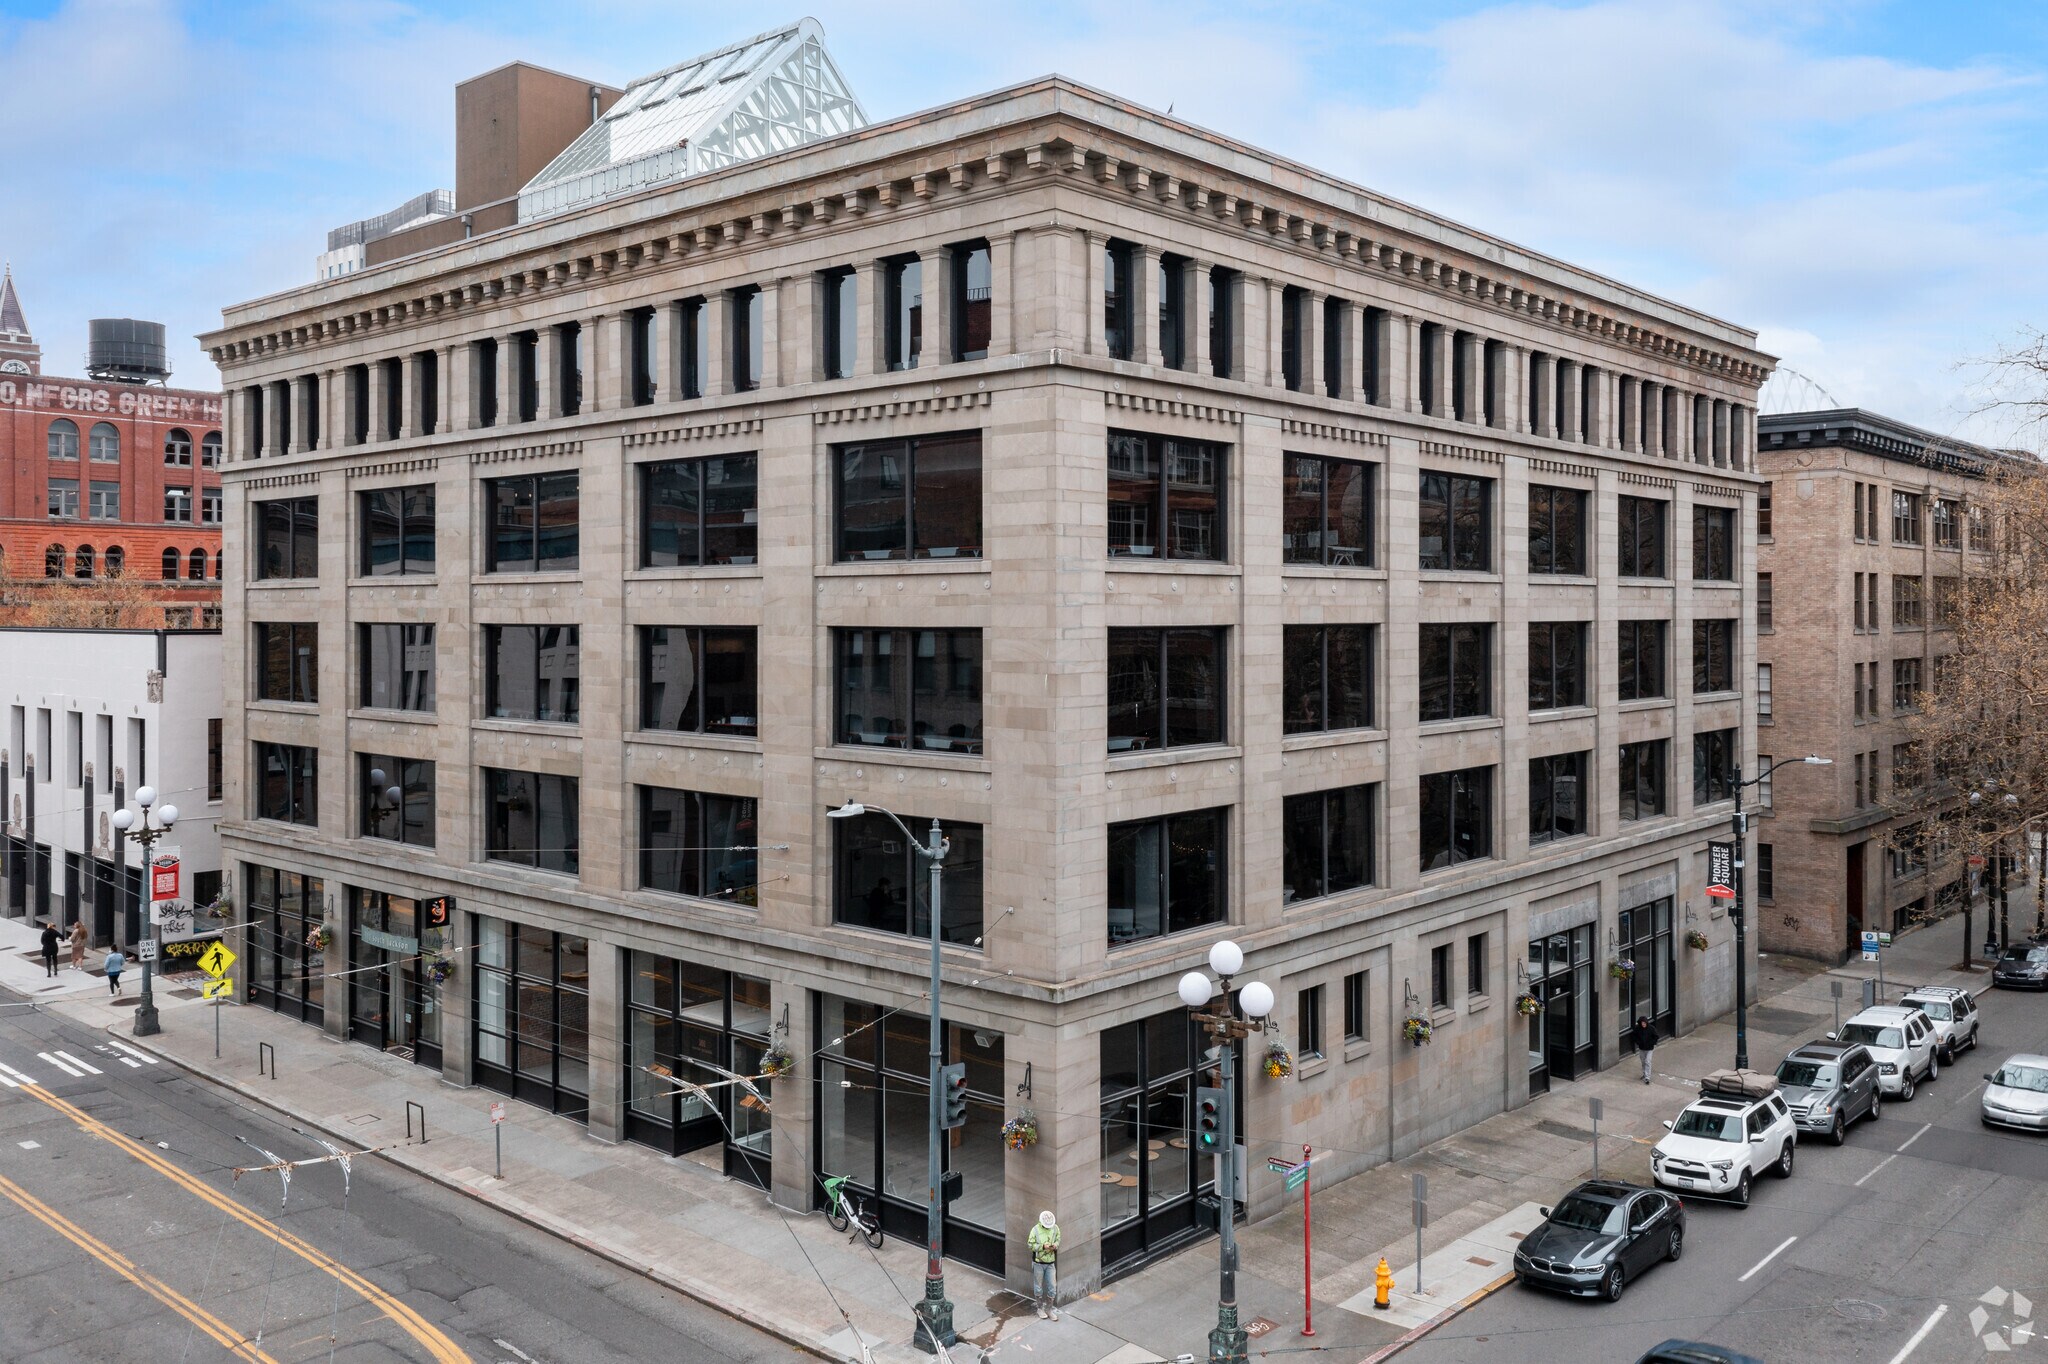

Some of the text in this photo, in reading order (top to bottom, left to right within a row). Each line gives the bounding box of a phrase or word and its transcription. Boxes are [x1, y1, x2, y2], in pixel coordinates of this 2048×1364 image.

[26, 382, 116, 413] MFGRS.
[119, 391, 196, 420] GREEN
[203, 399, 223, 421] H
[1712, 845, 1721, 883] PIONEER
[1721, 847, 1730, 884] SQUARE
